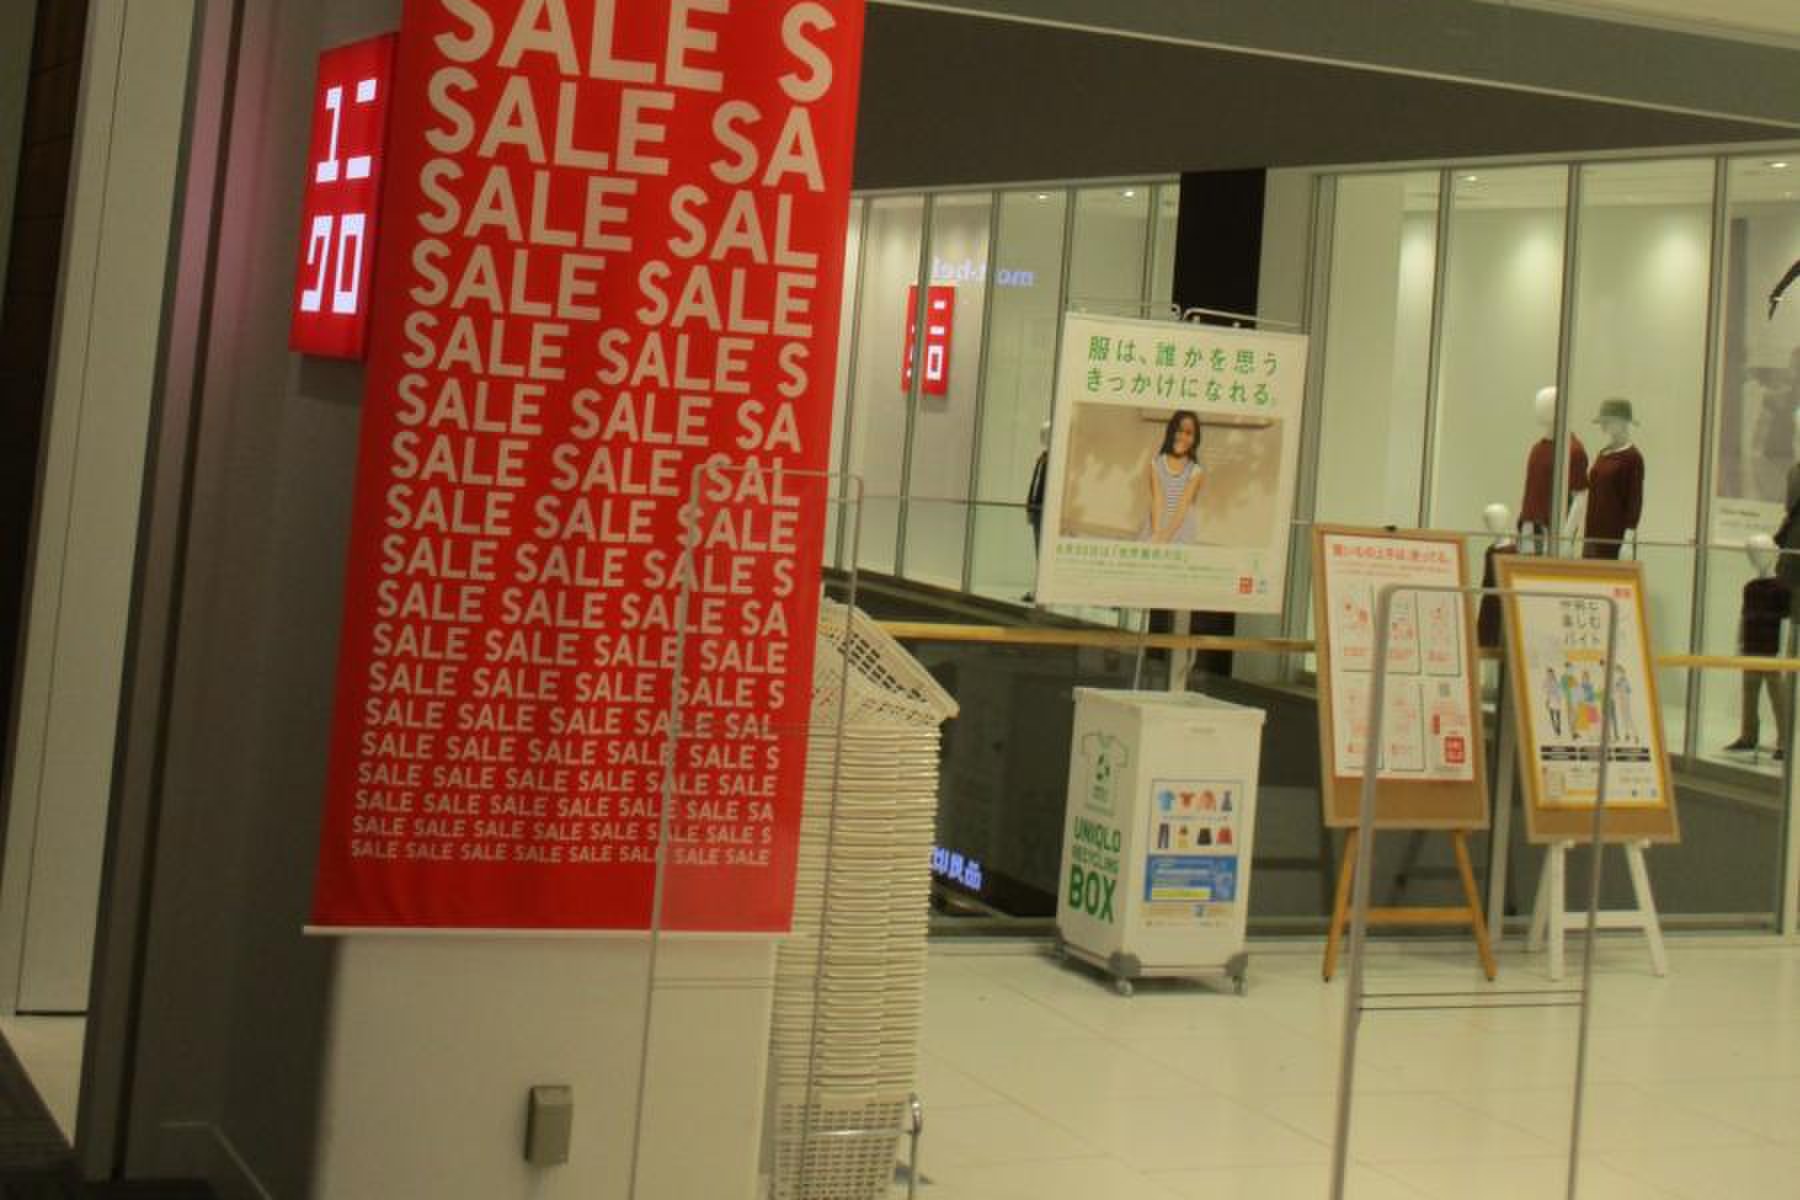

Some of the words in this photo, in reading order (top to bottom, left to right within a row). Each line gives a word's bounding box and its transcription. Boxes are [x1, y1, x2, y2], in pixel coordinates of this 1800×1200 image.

[778, 1, 836, 103] S
[425, 66, 676, 177] SALE
[710, 100, 826, 193] SA
[417, 157, 638, 252] SALE
[667, 184, 819, 269] SAL
[409, 238, 606, 321] SALE
[636, 260, 817, 339] SALE
[403, 310, 569, 381] SALE
[597, 328, 755, 394] SALE
[777, 341, 810, 399] S
[1088, 335, 1279, 376] 服は、誰かを思う
[396, 373, 546, 436] SALE
[570, 388, 713, 447] SALE
[735, 399, 802, 454] SA
[391, 430, 529, 488] SALE
[551, 443, 683, 497] SALE
[702, 452, 799, 507] SAL
[386, 484, 516, 536] SALE
[534, 495, 657, 544] SALE
[381, 533, 499, 581] SALE
[514, 543, 628, 588] SALE
[772, 557, 795, 598] S
[377, 579, 486, 623] SALE
[501, 587, 608, 630] SALE
[741, 599, 788, 638] SA
[373, 622, 470, 661] SALE
[484, 628, 581, 667] SALE
[700, 639, 789, 675] SALE
[368, 661, 458, 697] SALE
[472, 666, 561, 701] SALE
[575, 671, 657, 704] SALE
[768, 679, 785, 709] S
[365, 697, 446, 729] SALE
[458, 703, 536, 733] SALE
[549, 706, 624, 736] SALE
[724, 712, 779, 742] SAL
[358, 761, 423, 788] SALE
[433, 765, 497, 790] SALE
[505, 767, 570, 793] SALE
[578, 769, 636, 793] SALE
[718, 773, 778, 798] SALE
[361, 731, 435, 760] SALE
[446, 735, 517, 762] SALE
[527, 738, 598, 767] SALE
[689, 743, 757, 771] SALE
[766, 745, 780, 771] S
[352, 815, 407, 837] SALE
[413, 818, 467, 838] SALE
[473, 819, 525, 840] SALE
[533, 821, 585, 842] SALE
[589, 821, 639, 841] SALE
[705, 825, 755, 845] SALE
[760, 826, 772, 845] S
[355, 789, 415, 813] SALE
[423, 793, 481, 815] SALE
[489, 794, 549, 817] SALE
[557, 796, 612, 818] SALE
[685, 799, 739, 822] SALE
[748, 801, 774, 822] SA
[1074, 816, 1121, 853] UNIQLO
[351, 838, 400, 860] SALE
[404, 841, 454, 861] SALE
[460, 842, 508, 861] SALE
[512, 844, 564, 864] SALE
[568, 844, 614, 863] SALE
[672, 847, 721, 866] SALE
[725, 847, 771, 867] SALE
[1068, 865, 1117, 924] BOX
